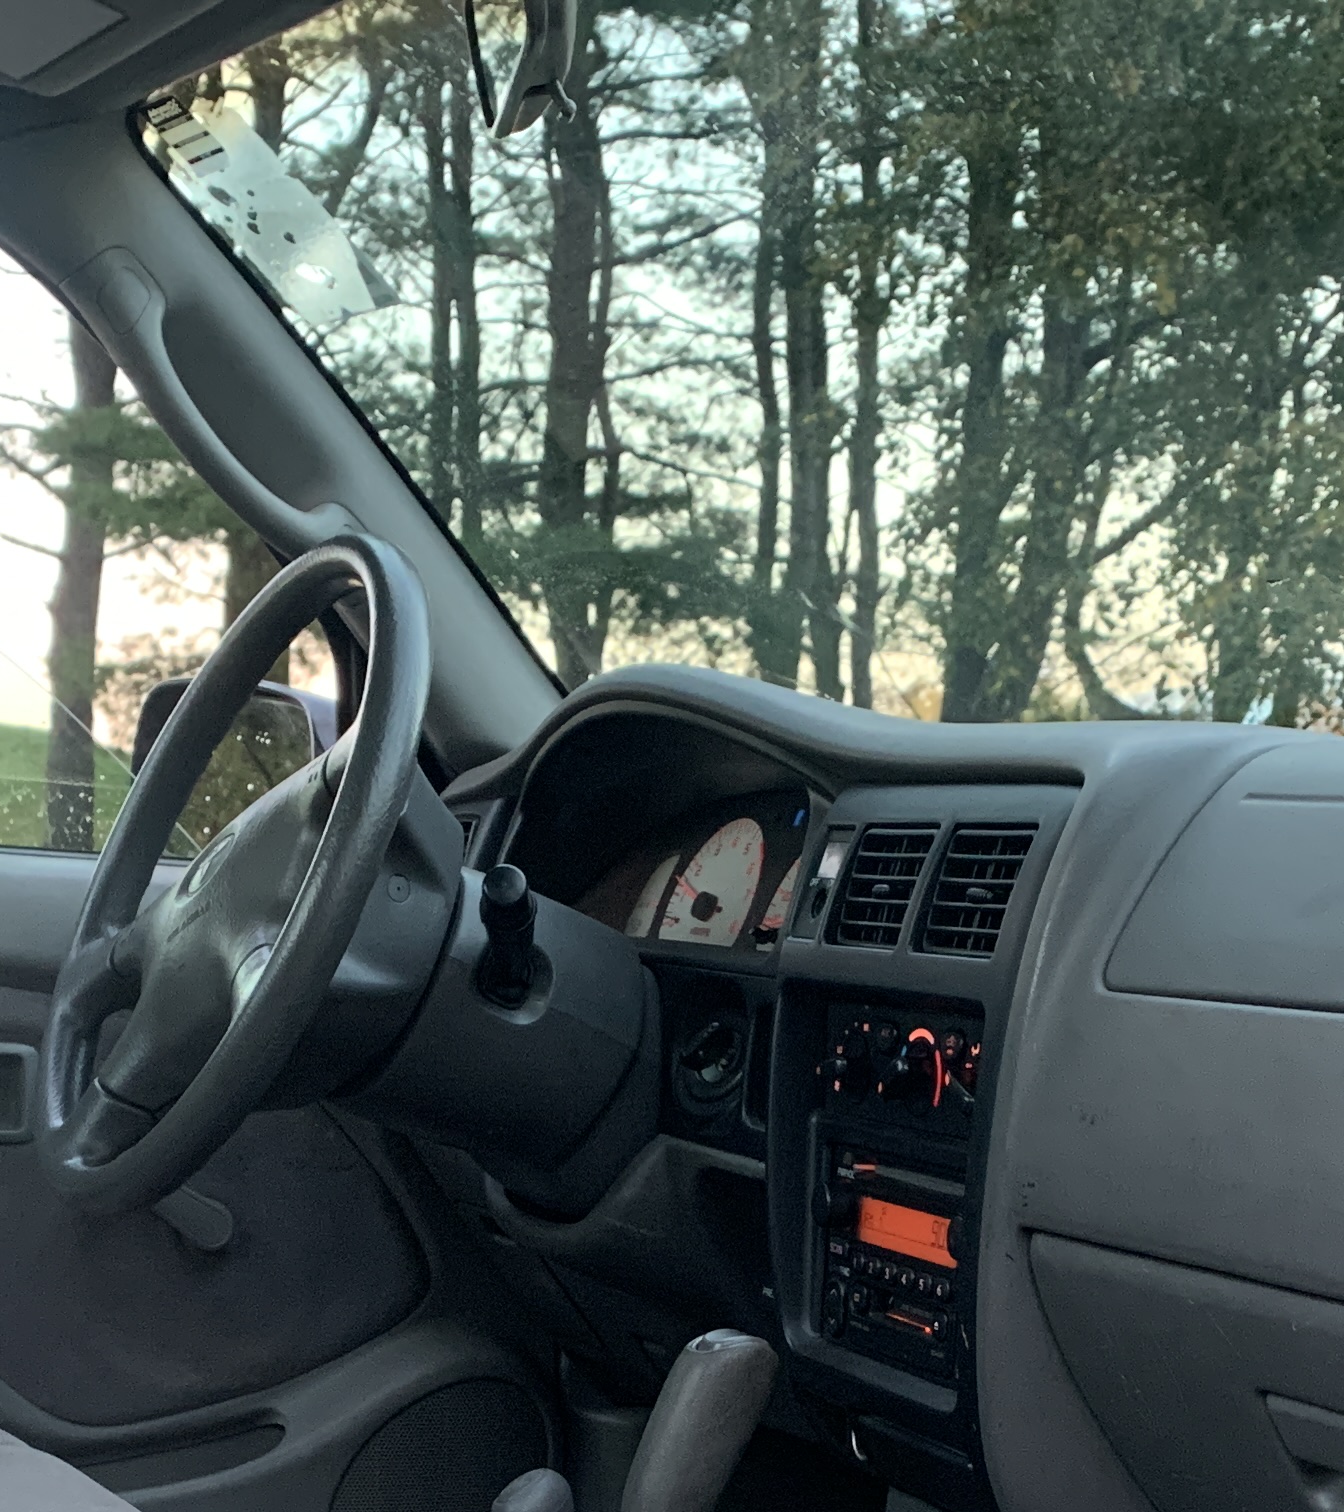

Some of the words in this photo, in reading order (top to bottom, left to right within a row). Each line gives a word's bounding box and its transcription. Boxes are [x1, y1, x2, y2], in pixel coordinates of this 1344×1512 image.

[868, 1261, 874, 1274] 2
[884, 1267, 890, 1280] 3
[900, 1273, 907, 1285] 4
[918, 1278, 925, 1291] 5
[936, 1284, 942, 1297] 6
